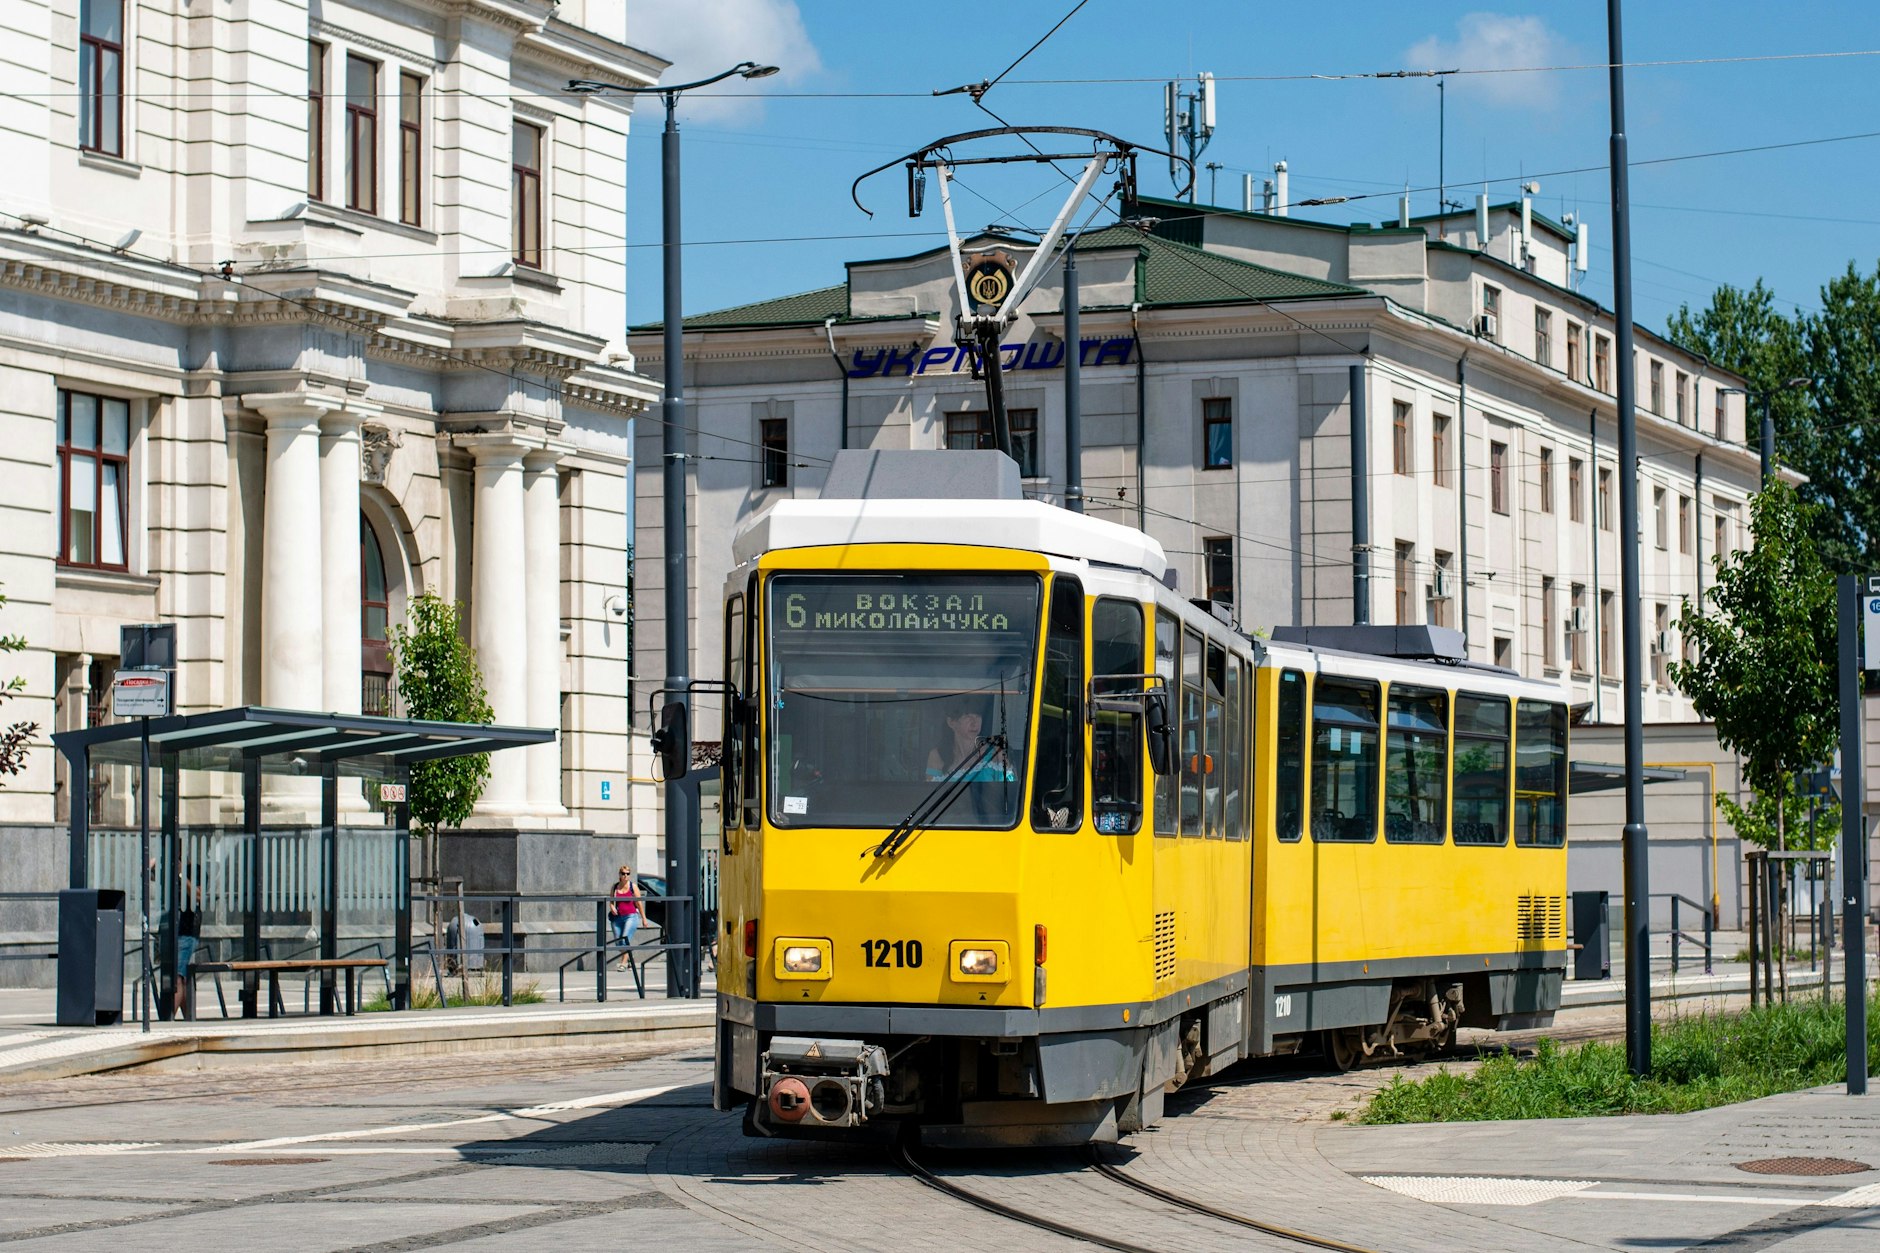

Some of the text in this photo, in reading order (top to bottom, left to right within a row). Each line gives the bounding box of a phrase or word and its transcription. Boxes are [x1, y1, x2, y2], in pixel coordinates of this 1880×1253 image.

[786, 593, 807, 629] 6
[856, 594, 984, 611] ВОКЗАЛ
[860, 939, 923, 968] 1210
[1275, 994, 1291, 1018] 1210
